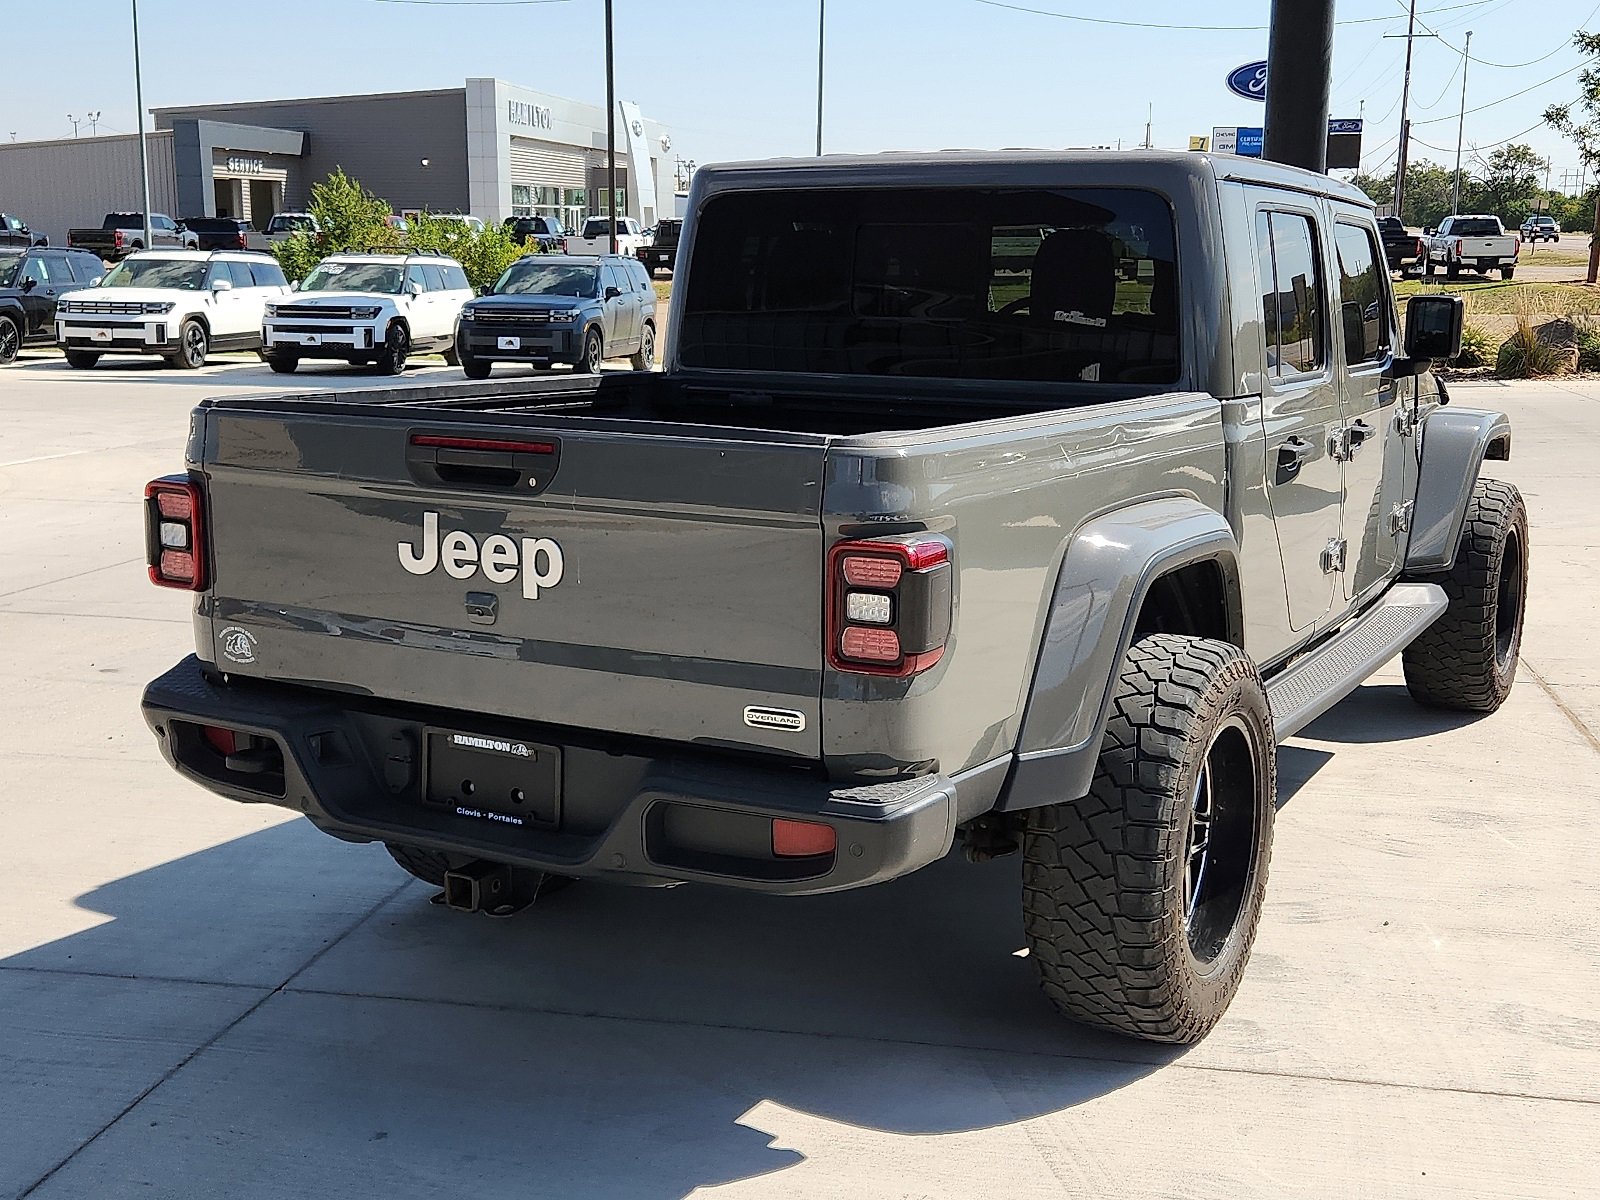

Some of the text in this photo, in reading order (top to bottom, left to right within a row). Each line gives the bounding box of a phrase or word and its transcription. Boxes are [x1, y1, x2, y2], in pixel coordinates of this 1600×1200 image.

[508, 100, 552, 130] HAMILTON
[228, 157, 263, 172] SERVICE
[397, 511, 564, 600] Jeep
[746, 713, 801, 725] OVERLAND
[453, 734, 511, 753] HAMILTON
[456, 807, 482, 818] Clovis
[488, 812, 523, 826] Portales
